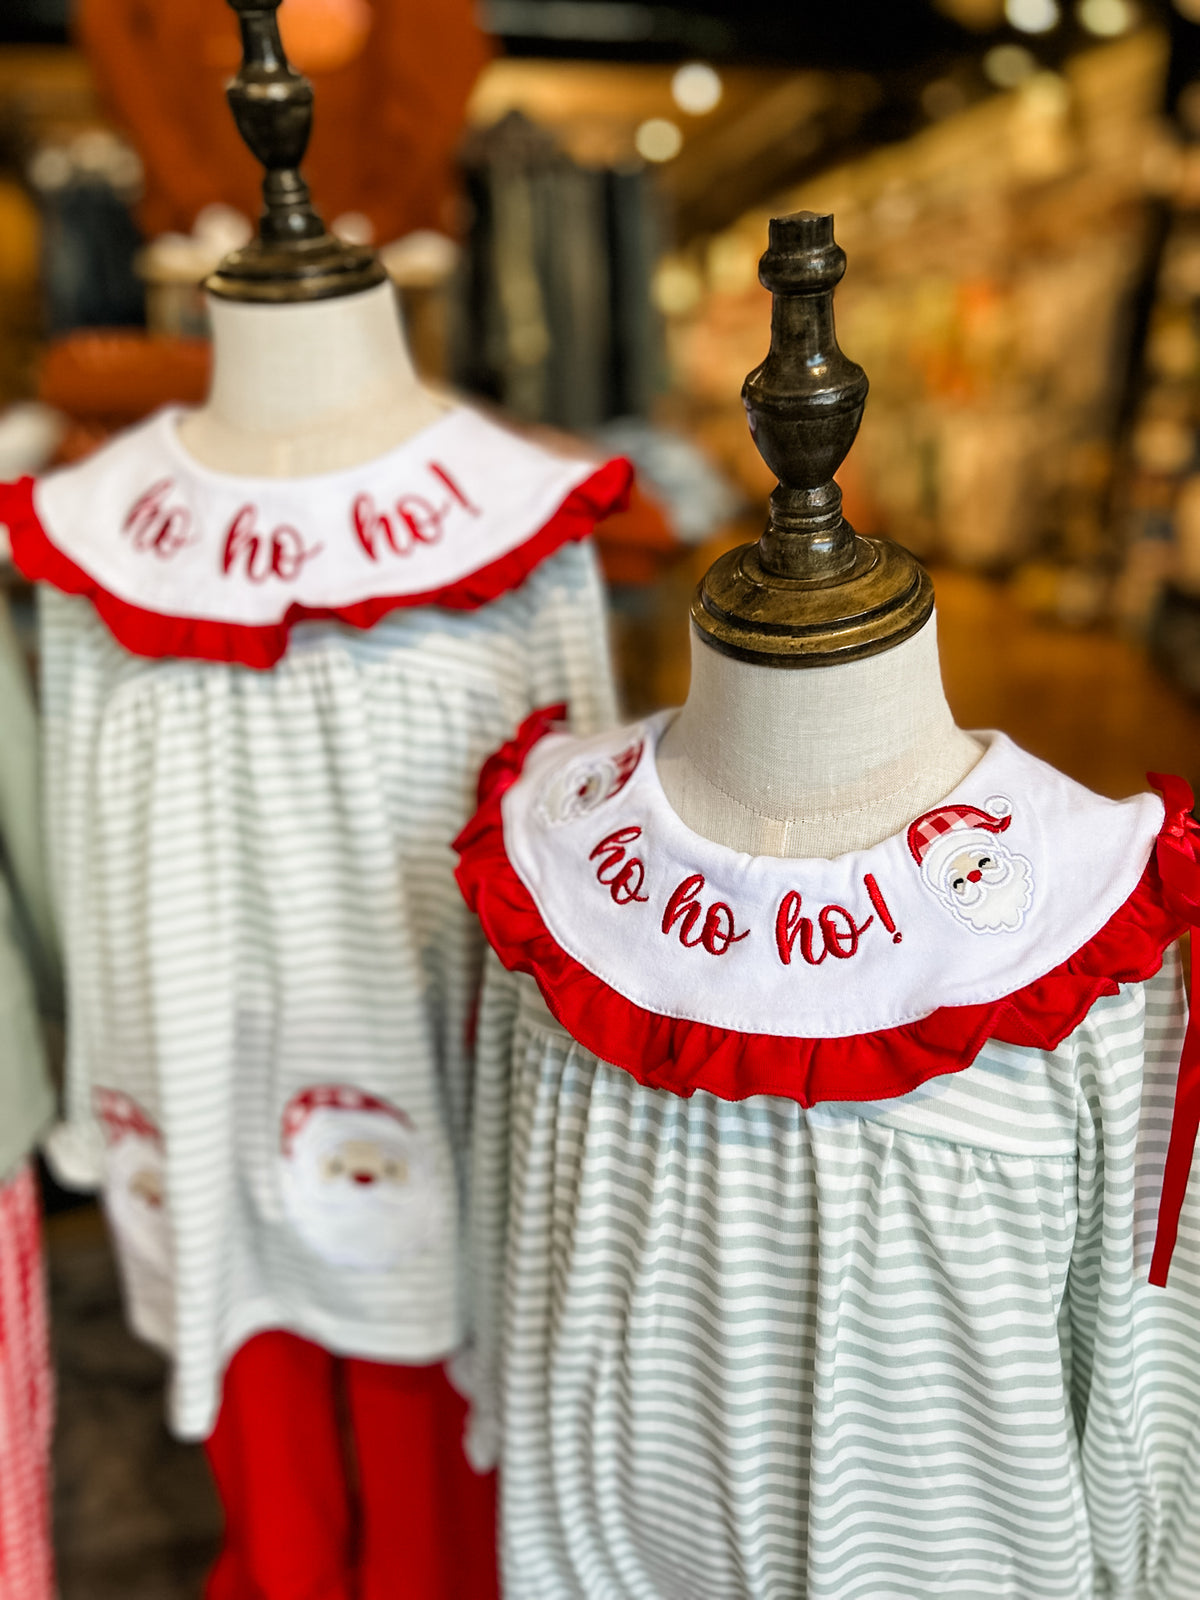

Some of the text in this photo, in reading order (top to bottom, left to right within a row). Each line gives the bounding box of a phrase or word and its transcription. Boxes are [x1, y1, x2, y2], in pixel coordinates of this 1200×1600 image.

[122, 459, 482, 584] ho ho ho!
[588, 825, 903, 966] ho ho ho!
